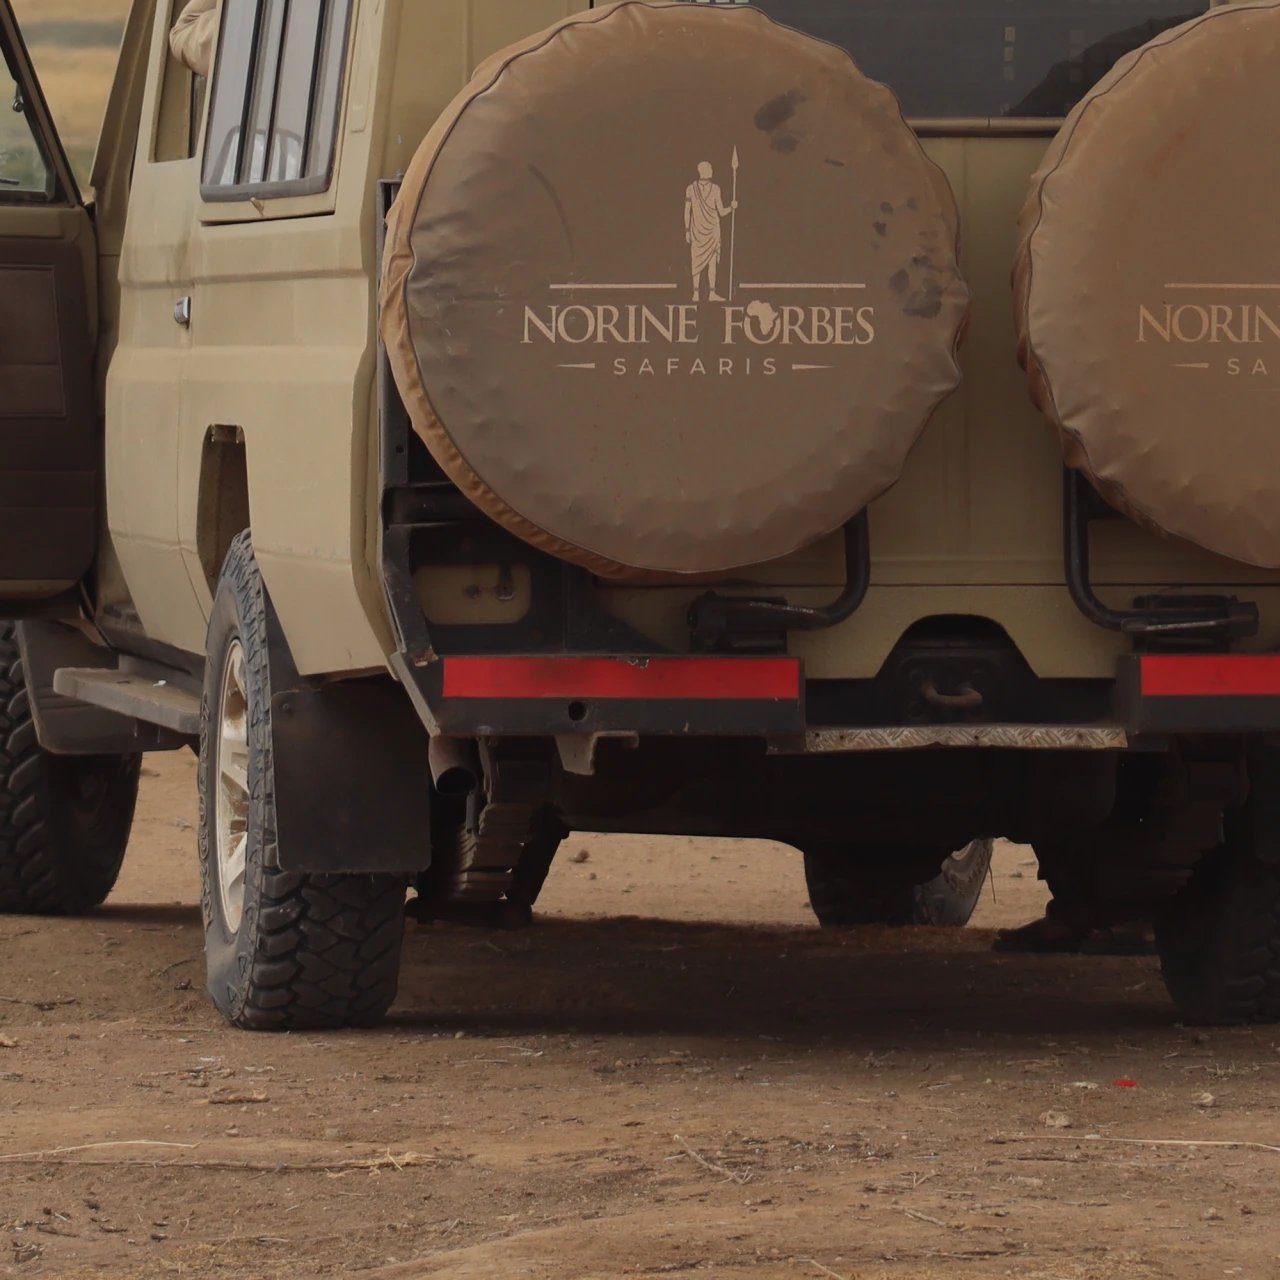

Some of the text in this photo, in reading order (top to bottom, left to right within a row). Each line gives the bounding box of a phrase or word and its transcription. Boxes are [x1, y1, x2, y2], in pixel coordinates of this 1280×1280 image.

[520, 299, 875, 345] NORINE FORBES
[613, 358, 777, 376] SAFARIS
